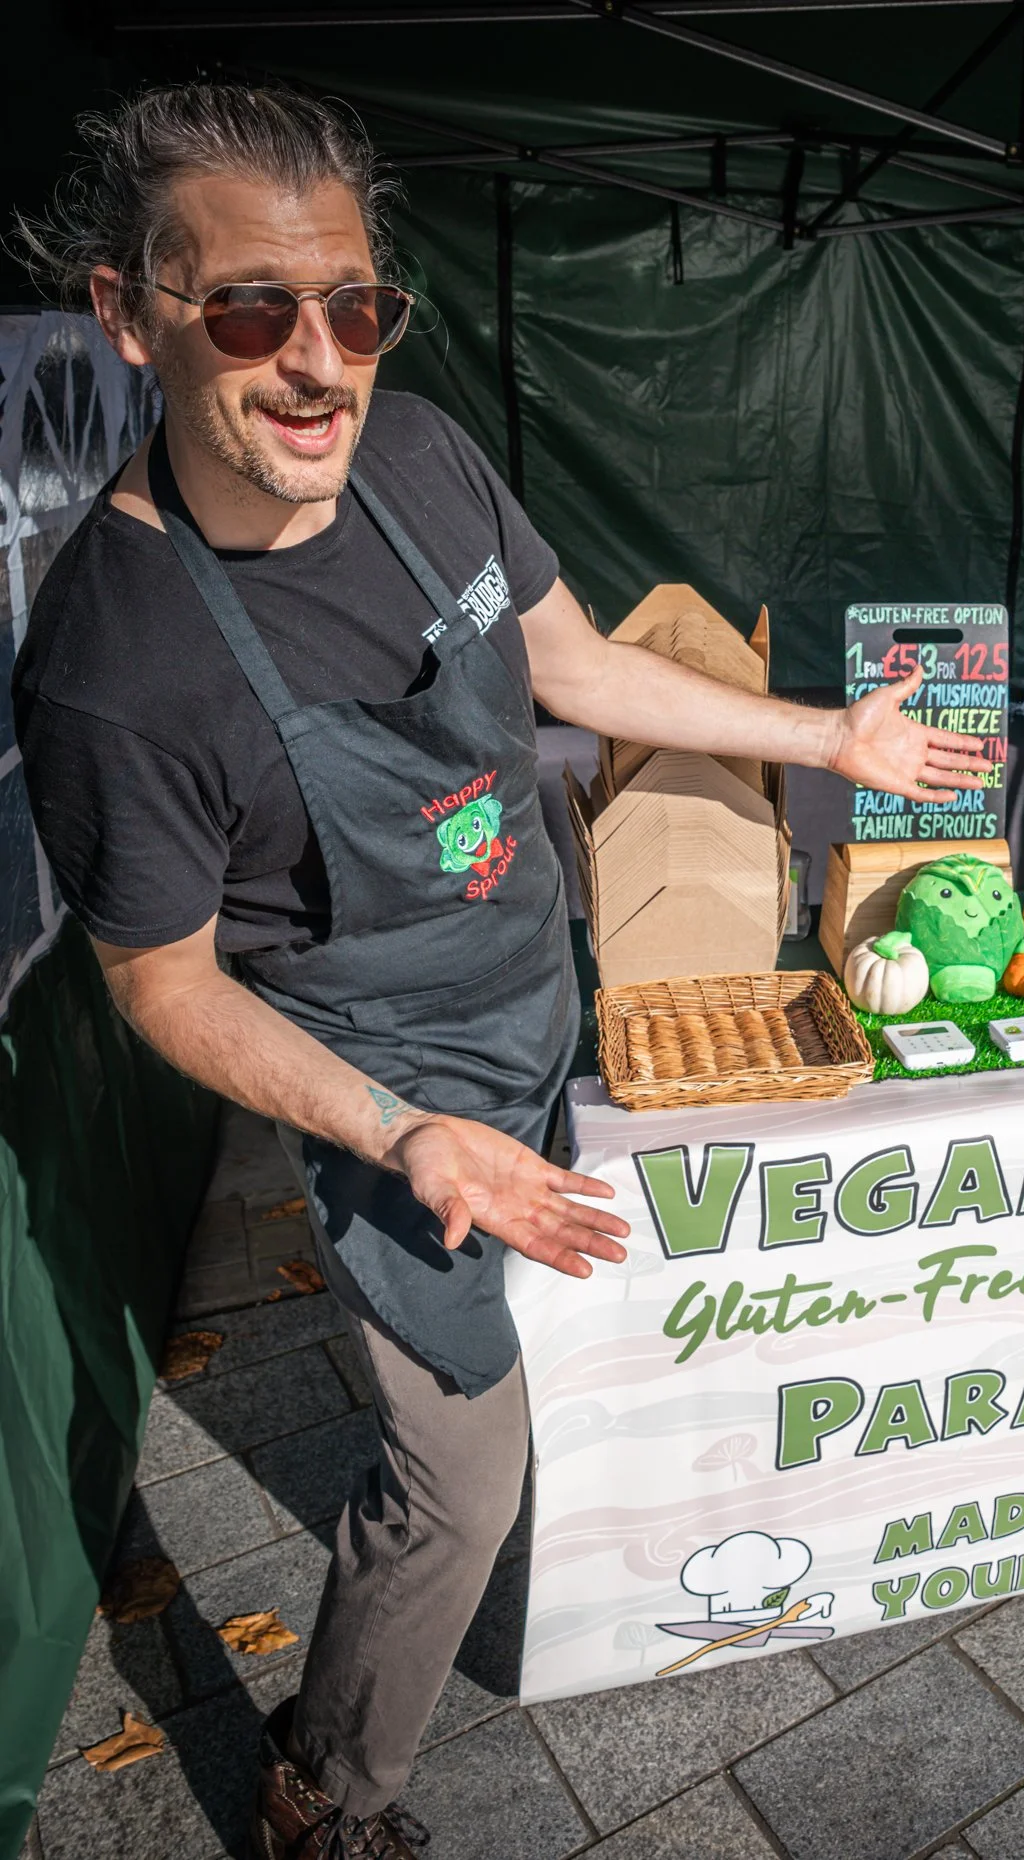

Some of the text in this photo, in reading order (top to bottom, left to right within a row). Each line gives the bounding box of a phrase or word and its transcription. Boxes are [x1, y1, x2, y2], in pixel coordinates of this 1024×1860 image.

[954, 606, 1003, 625] OPTION
[882, 643, 919, 679] £5
[921, 643, 938, 680] 3
[936, 661, 957, 679] FOR
[927, 683, 1008, 709] MUSHROOM
[937, 708, 1002, 734] CHEEZE
[421, 770, 498, 823] Happy
[854, 789, 905, 815] FACON
[851, 813, 998, 841] TAHINI SPROUTS
[466, 835, 518, 900] Sprout
